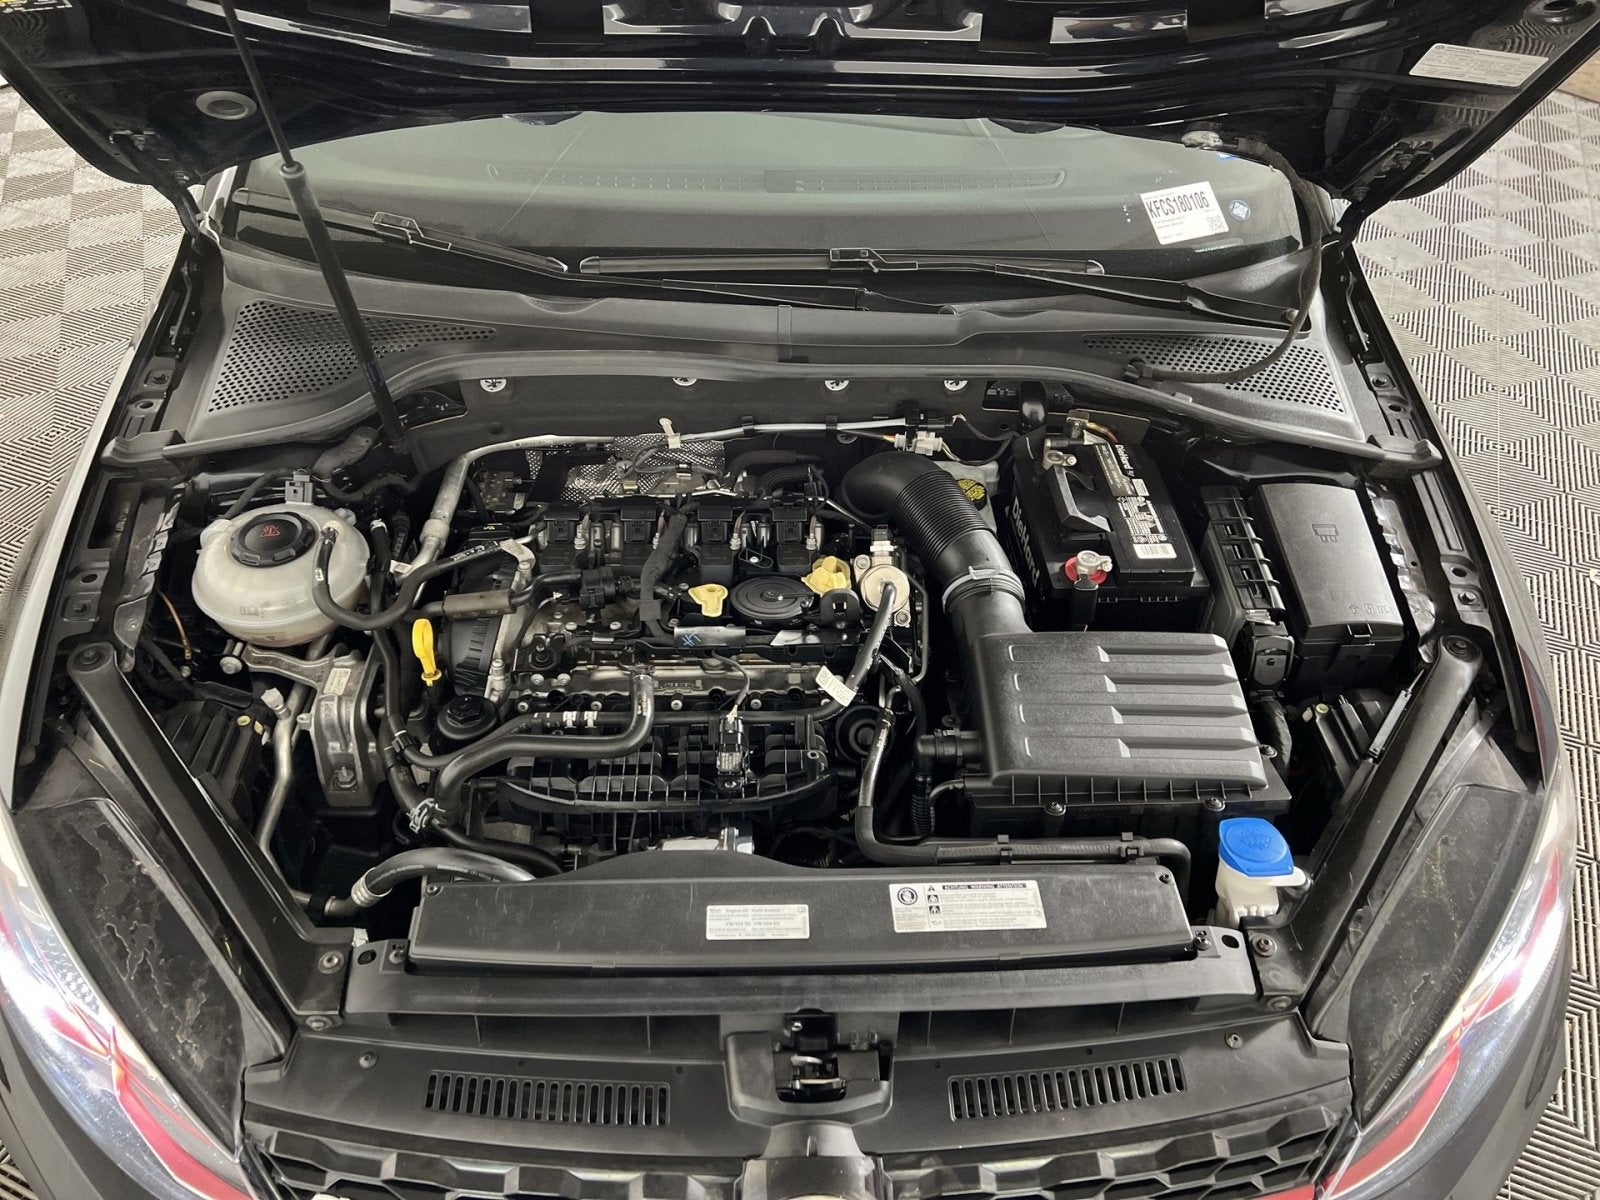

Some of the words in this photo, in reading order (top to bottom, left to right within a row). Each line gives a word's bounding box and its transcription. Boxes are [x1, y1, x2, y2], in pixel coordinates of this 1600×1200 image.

[1146, 191, 1209, 218] KFCS180106
[1115, 444, 1133, 470] DieHard
[1011, 496, 1040, 586] DieHard
